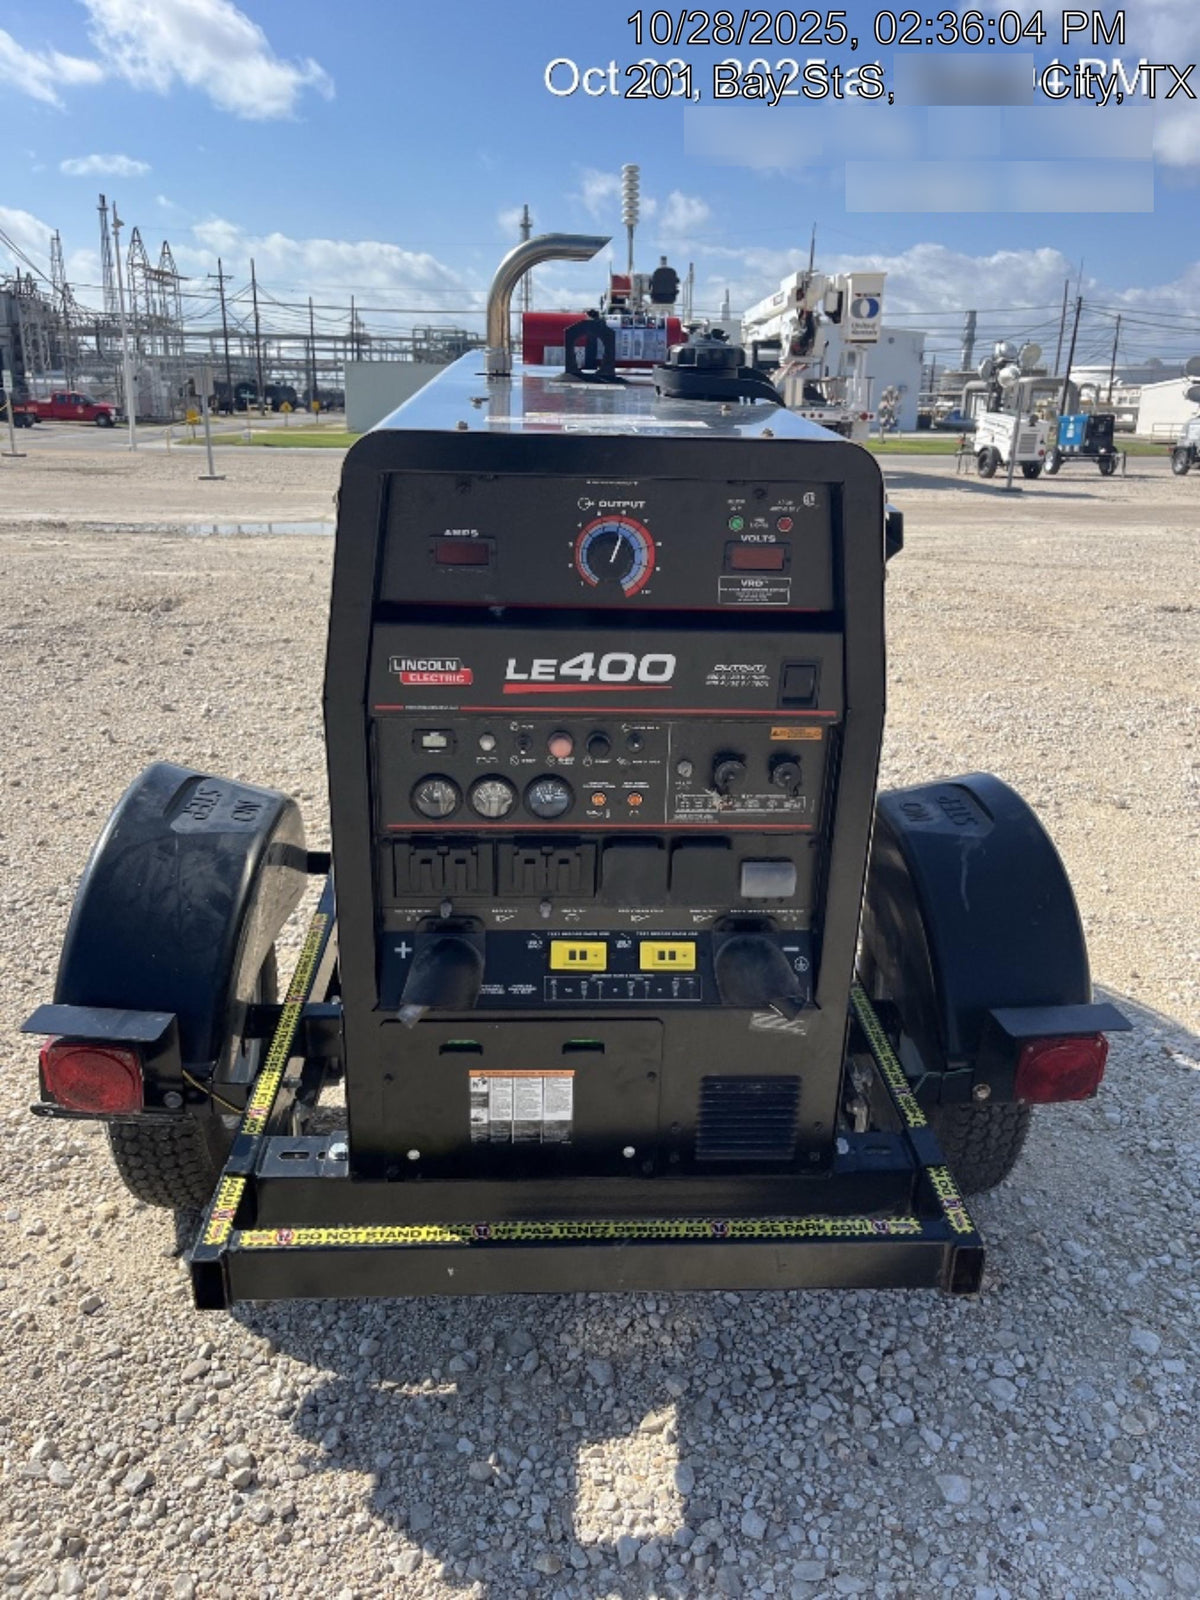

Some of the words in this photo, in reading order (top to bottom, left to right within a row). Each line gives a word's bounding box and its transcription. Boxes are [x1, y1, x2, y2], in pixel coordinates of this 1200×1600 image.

[599, 501, 646, 509] OUTPUT
[741, 534, 776, 543] VOLTS
[393, 659, 457, 672] LINCOLN
[505, 652, 677, 682] LE400
[408, 672, 465, 684] ELECTRIC
[521, 1227, 554, 1235] PAS
[555, 1226, 610, 1235] TENEZ
[686, 1224, 706, 1232] ICI
[732, 1225, 755, 1233] NO
[759, 1224, 781, 1232] SE
[326, 1231, 362, 1240] NOT
[366, 1230, 422, 1239] STAND
